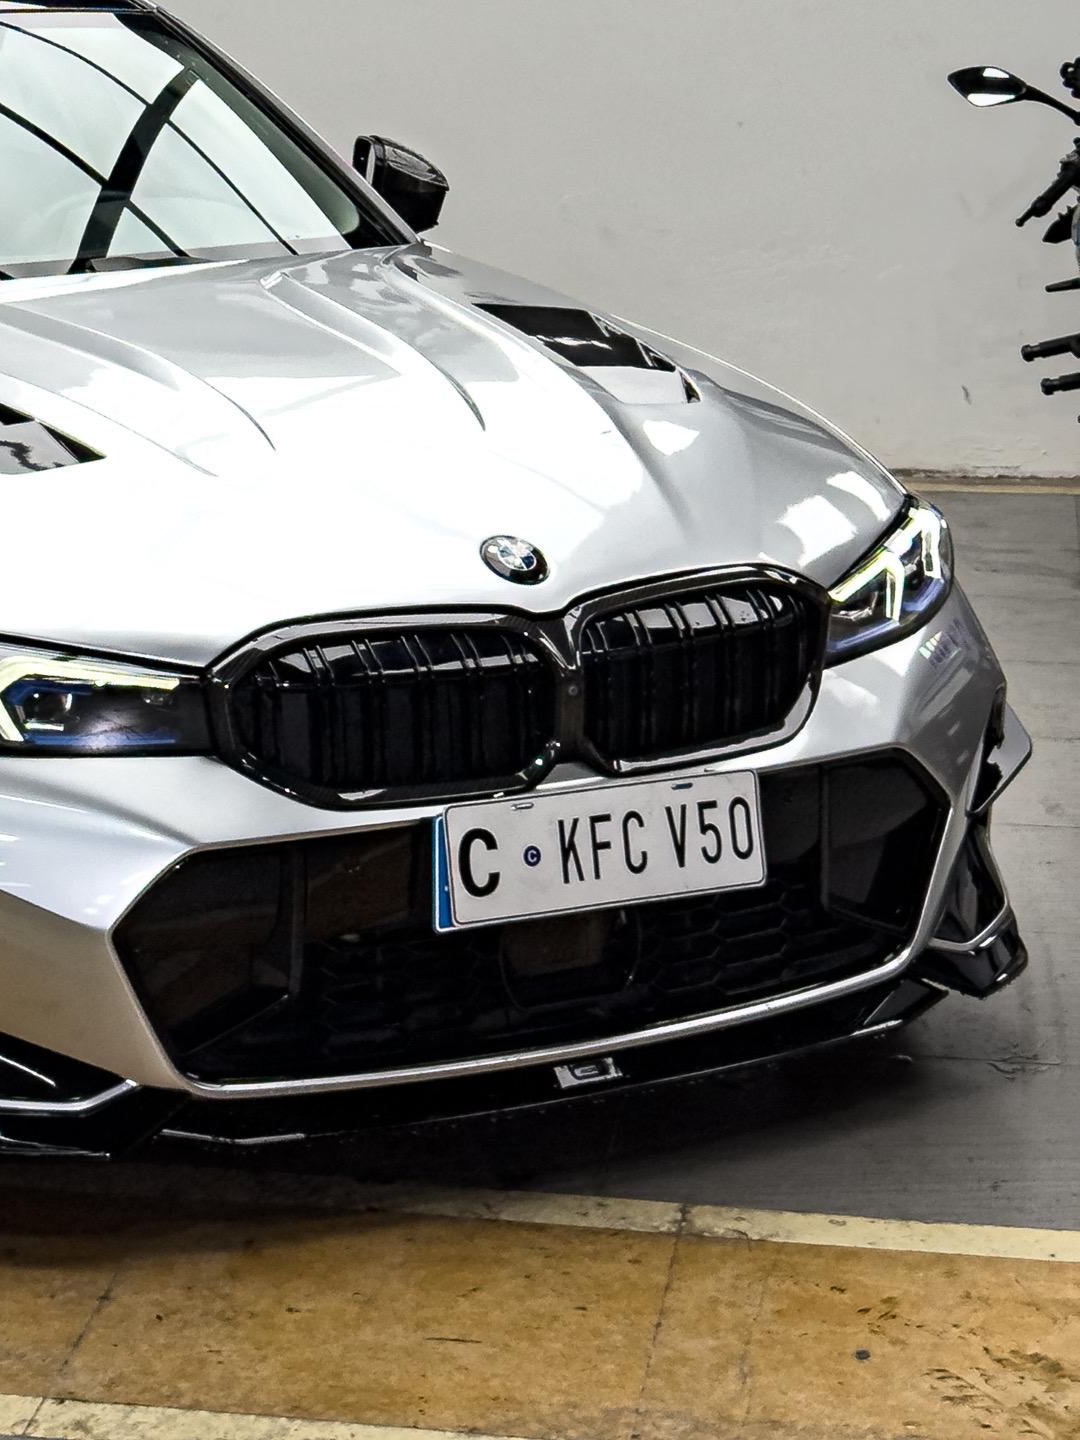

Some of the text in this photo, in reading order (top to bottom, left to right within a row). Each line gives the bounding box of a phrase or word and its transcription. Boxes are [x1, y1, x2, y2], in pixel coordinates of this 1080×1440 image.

[458, 796, 755, 898] C KFC V50
